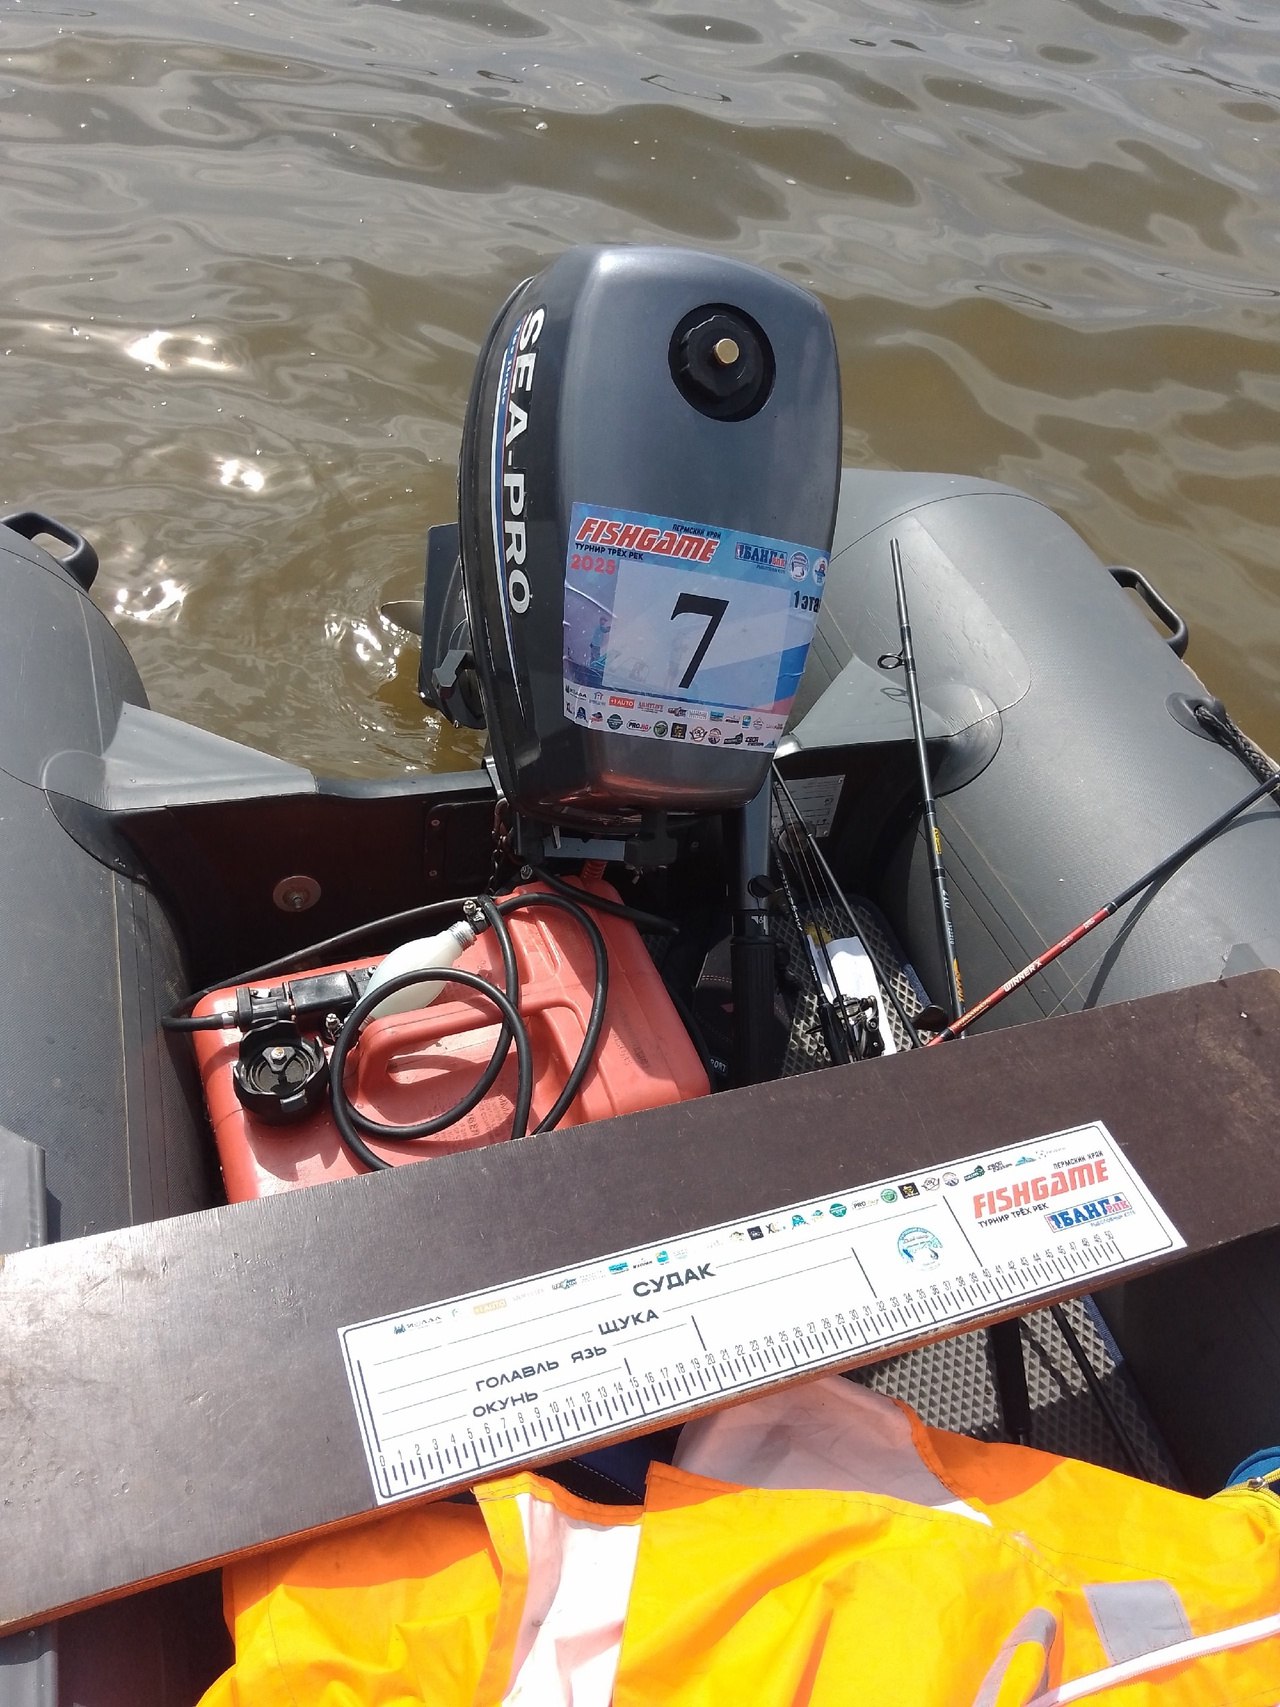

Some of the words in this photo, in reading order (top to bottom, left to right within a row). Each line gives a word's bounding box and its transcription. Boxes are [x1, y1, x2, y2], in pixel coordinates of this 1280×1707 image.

[504, 307, 546, 615] SEA-PRO
[575, 543, 606, 554] ТУРНИР
[607, 547, 627, 558] ТРЁХ
[628, 552, 644, 560] РЕК
[576, 517, 720, 563] FISHGAME
[571, 554, 616, 575] 2025
[794, 590, 800, 608] 1
[801, 595, 821, 613] эта
[670, 593, 730, 689] 7
[1003, 968, 1036, 992] WINNER
[1052, 1155, 1086, 1169] ПЕРМСКИЙ
[973, 1159, 1109, 1219] FISHGAME
[977, 1214, 1010, 1228] ТУРНИР
[1010, 1207, 1032, 1219] ТРЁХ
[1033, 1202, 1049, 1213] РЕК
[632, 1263, 716, 1298] СУДАК
[598, 1309, 659, 1336] ЩУКА
[550, 1402, 559, 1413] 10
[566, 1397, 575, 1408] 11
[582, 1391, 591, 1403] 12
[598, 1386, 607, 1397] 13
[614, 1382, 623, 1393] 14
[630, 1377, 639, 1388] 15
[645, 1372, 655, 1383] 16
[660, 1367, 668, 1378] 17
[676, 1363, 685, 1373] 18
[691, 1358, 700, 1369] 19
[705, 1353, 715, 1364] 20
[720, 1349, 729, 1360] 21
[735, 1345, 744, 1355] 22
[749, 1340, 759, 1350] 23
[764, 1336, 774, 1346] 24
[779, 1331, 788, 1342] 25
[793, 1327, 803, 1337] 26
[807, 1322, 815, 1333] 27
[821, 1318, 831, 1328] 28
[835, 1313, 845, 1324] 29
[849, 1309, 859, 1319] 30
[570, 1345, 607, 1365] ЯЗЬ
[475, 1360, 559, 1392] ГОЛАВЛЬ
[472, 1390, 539, 1418] ОКУНЬ
